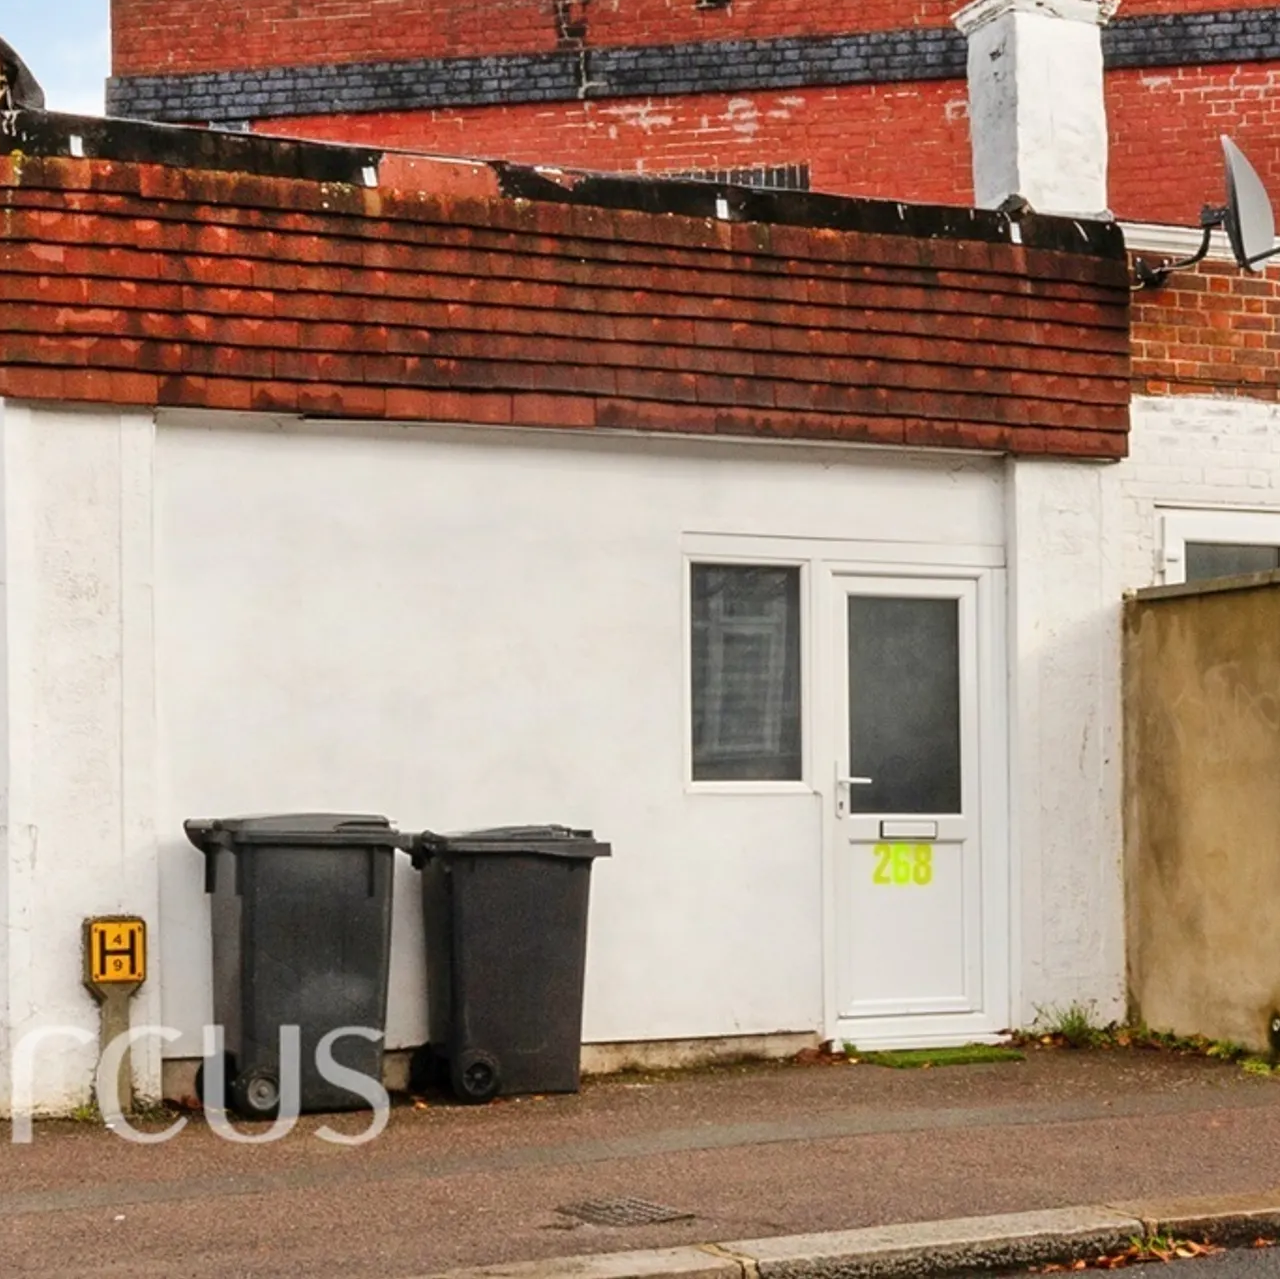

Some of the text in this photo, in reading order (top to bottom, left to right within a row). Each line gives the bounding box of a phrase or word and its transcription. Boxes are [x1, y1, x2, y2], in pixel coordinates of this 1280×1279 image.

[872, 841, 933, 886] 268
[99, 929, 136, 976] H
[112, 933, 122, 946] 4
[112, 958, 123, 972] 9
